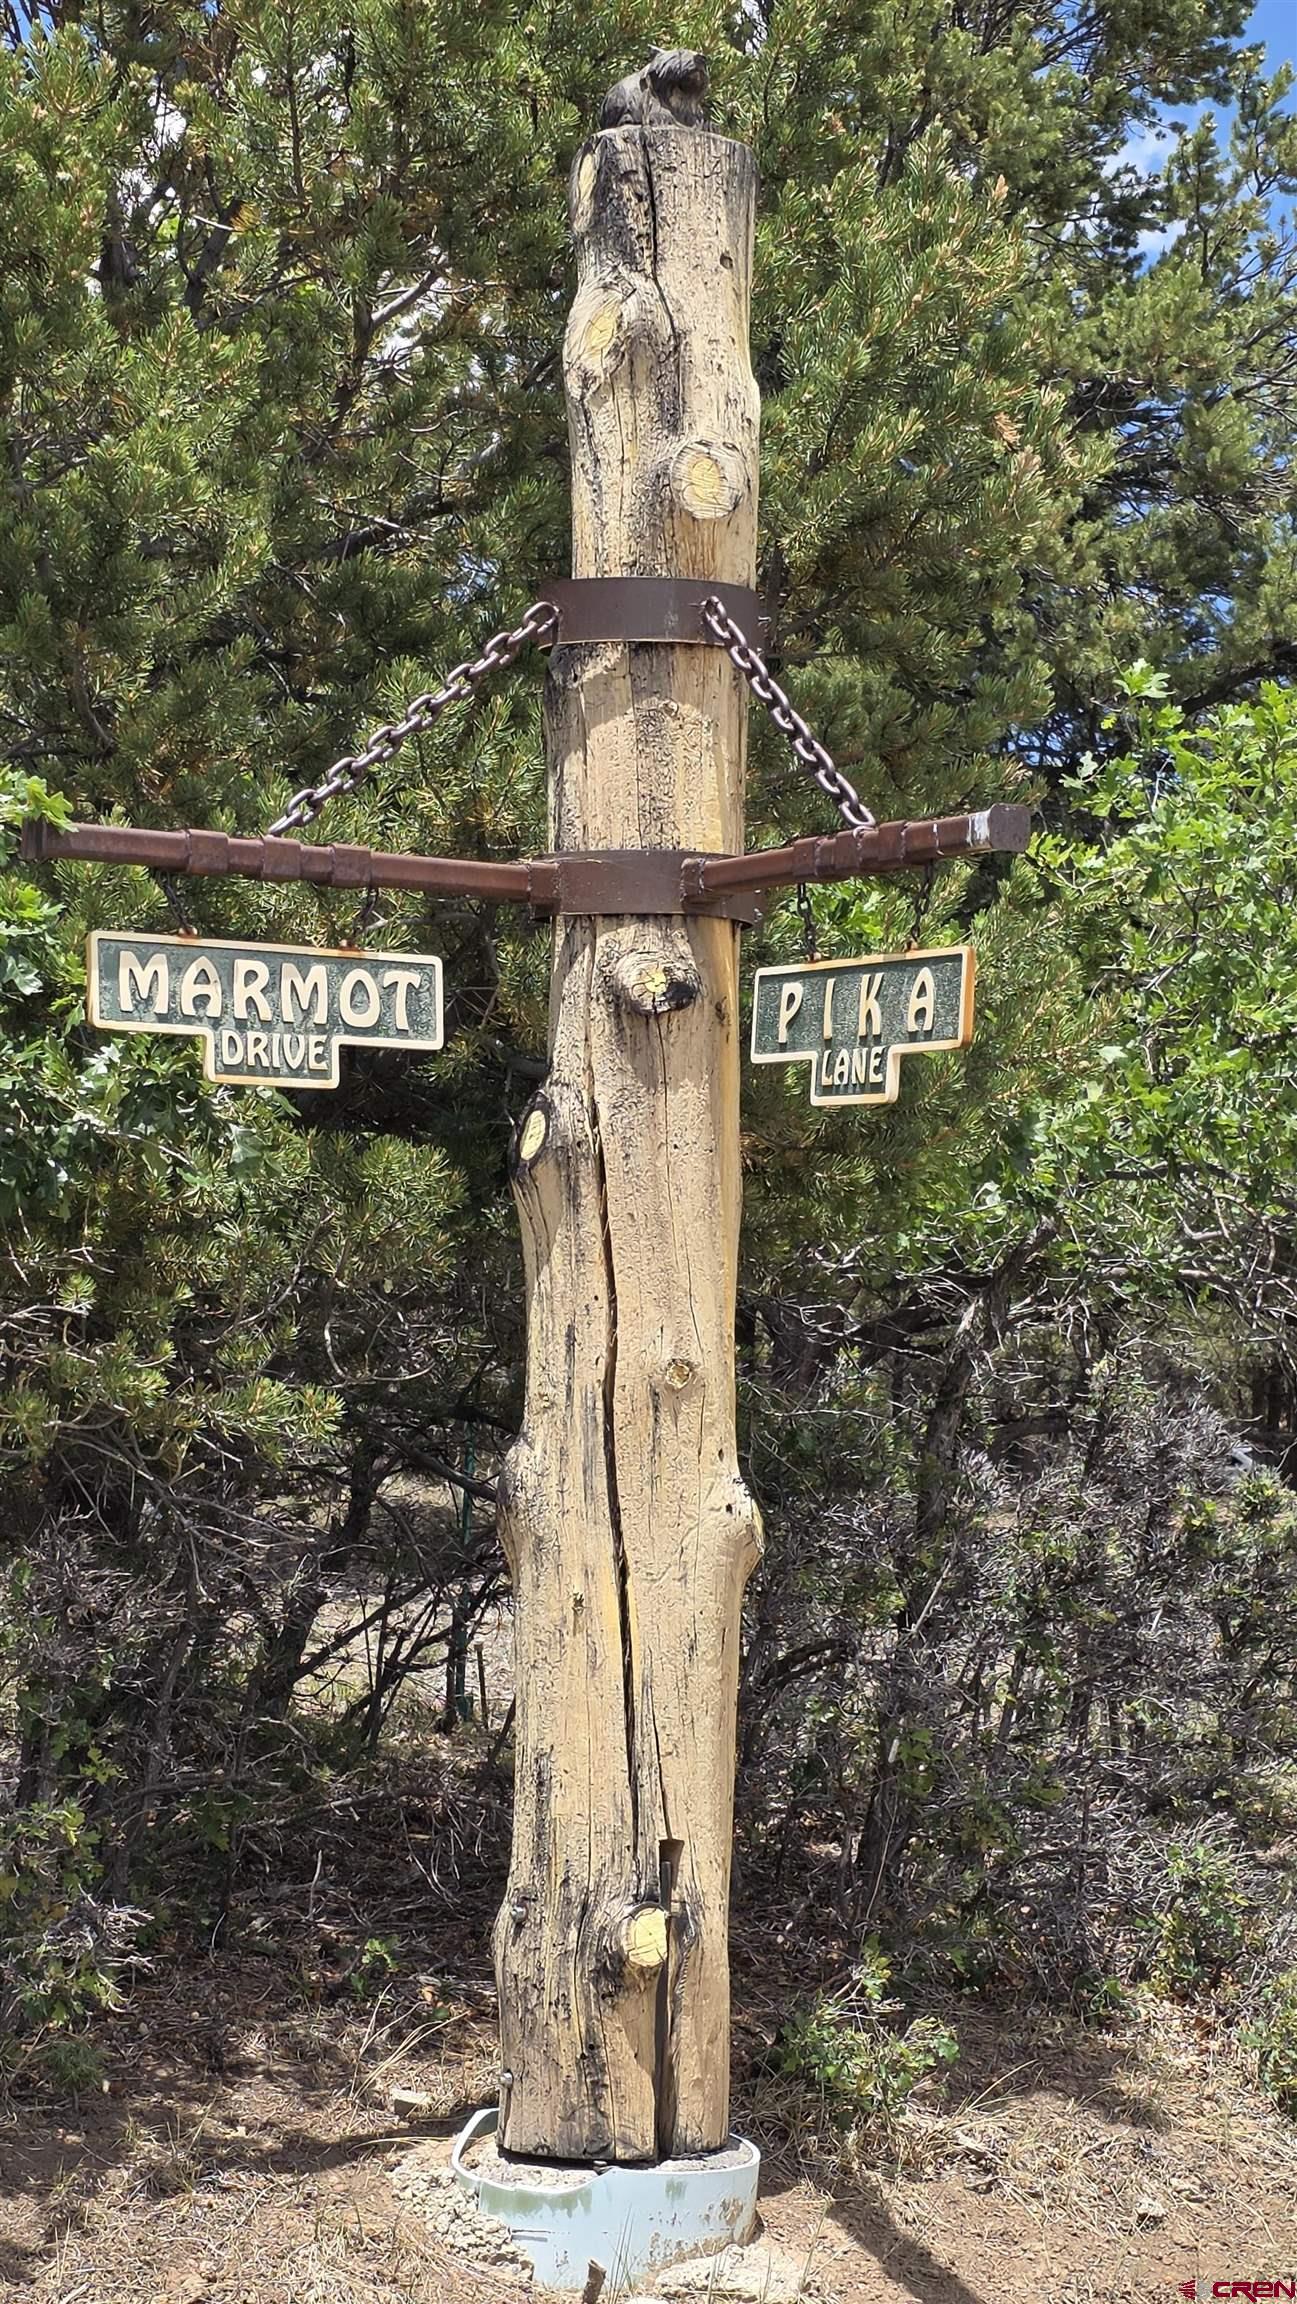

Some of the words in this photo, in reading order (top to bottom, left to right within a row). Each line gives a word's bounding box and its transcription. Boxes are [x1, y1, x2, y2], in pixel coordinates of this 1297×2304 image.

[119, 951, 422, 1031] MARMOT
[778, 967, 935, 1043] PIKA
[220, 1030, 329, 1071] DRIVE
[821, 1046, 884, 1086] LANE
